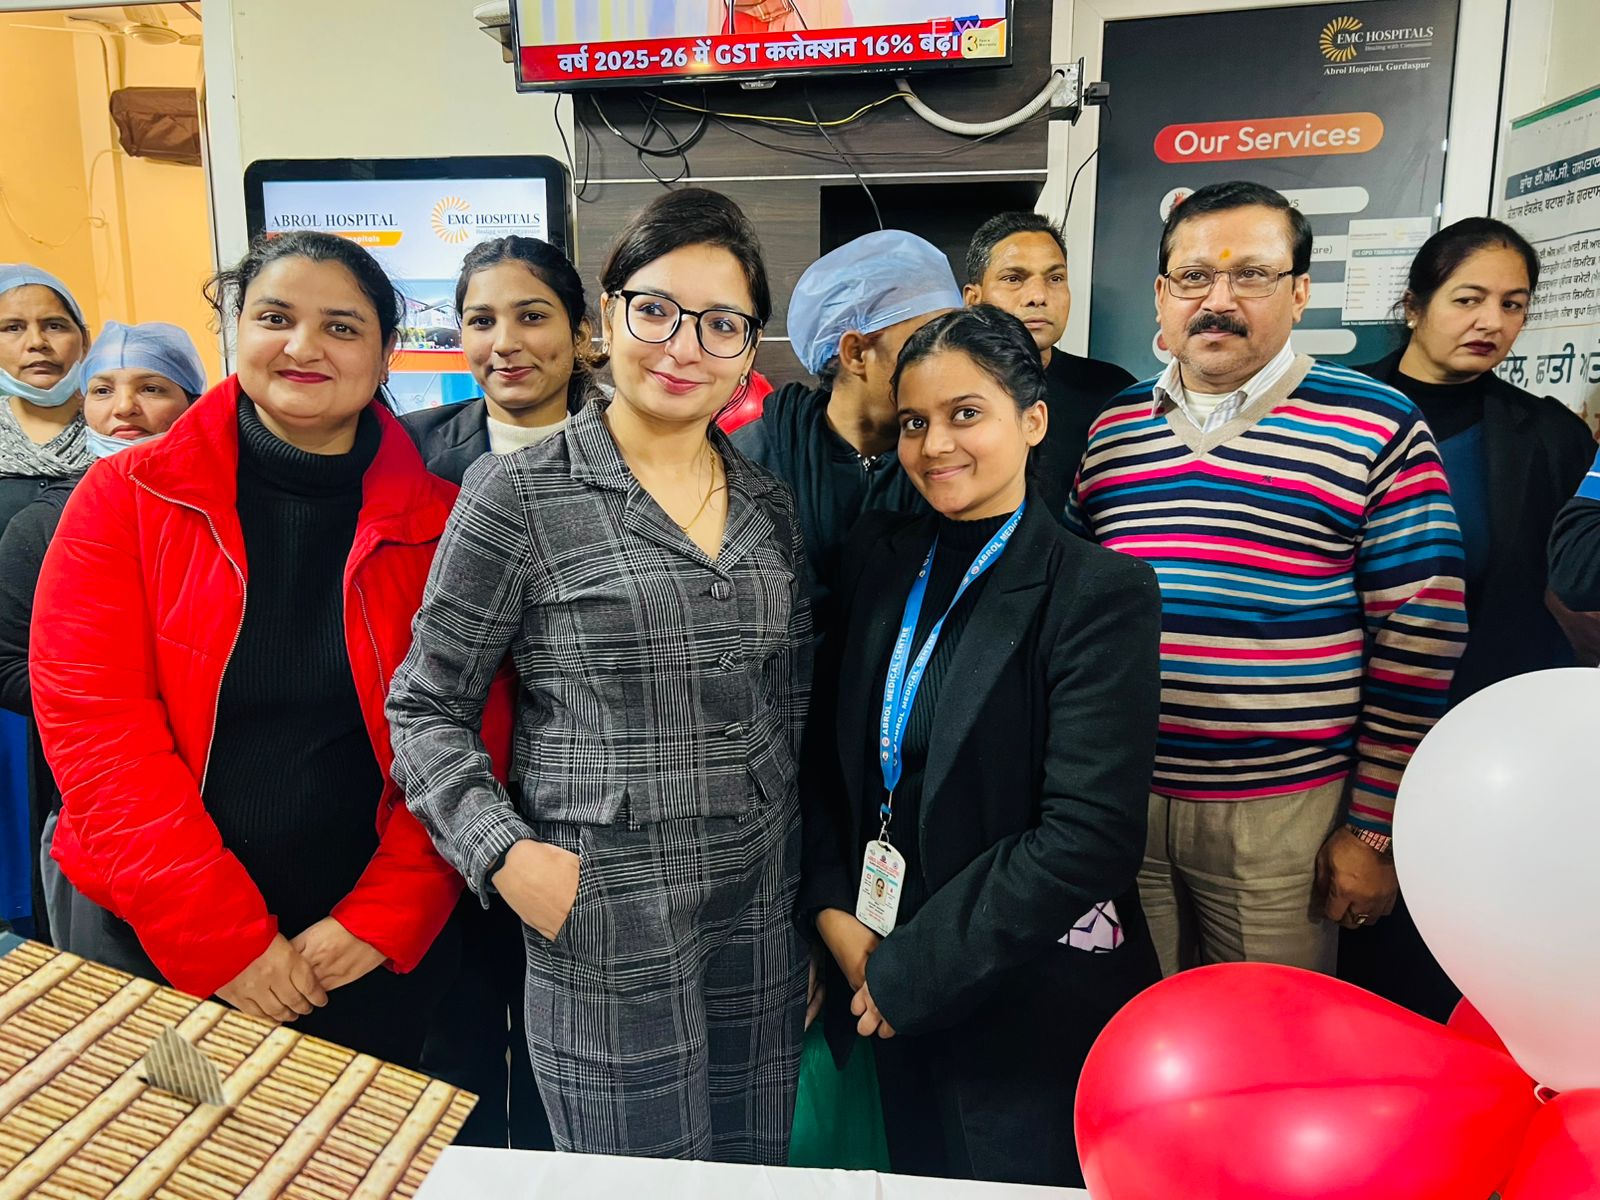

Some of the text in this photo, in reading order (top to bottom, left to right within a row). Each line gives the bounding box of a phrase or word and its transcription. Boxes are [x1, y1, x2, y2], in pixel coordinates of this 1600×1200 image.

[1337, 26, 1434, 44] EMC HOSPITALS
[557, 45, 589, 72] वर्ष
[594, 48, 688, 71] 2025-26
[692, 38, 712, 65] में
[715, 42, 760, 65] GST
[764, 33, 857, 61] कलेक्शन
[861, 34, 914, 56] 16%
[1324, 66, 1347, 76] Abrol
[1386, 61, 1431, 73] Gurdaspur
[1174, 123, 1361, 155] Our Services
[271, 213, 398, 227] ABROL HOSPITAL
[447, 213, 540, 225] EMC HOSPITALS
[978, 540, 1002, 567] ABROL
[882, 626, 912, 736] ABROL MEDICAL CENTRE
[901, 669, 919, 710] MEDICAL
